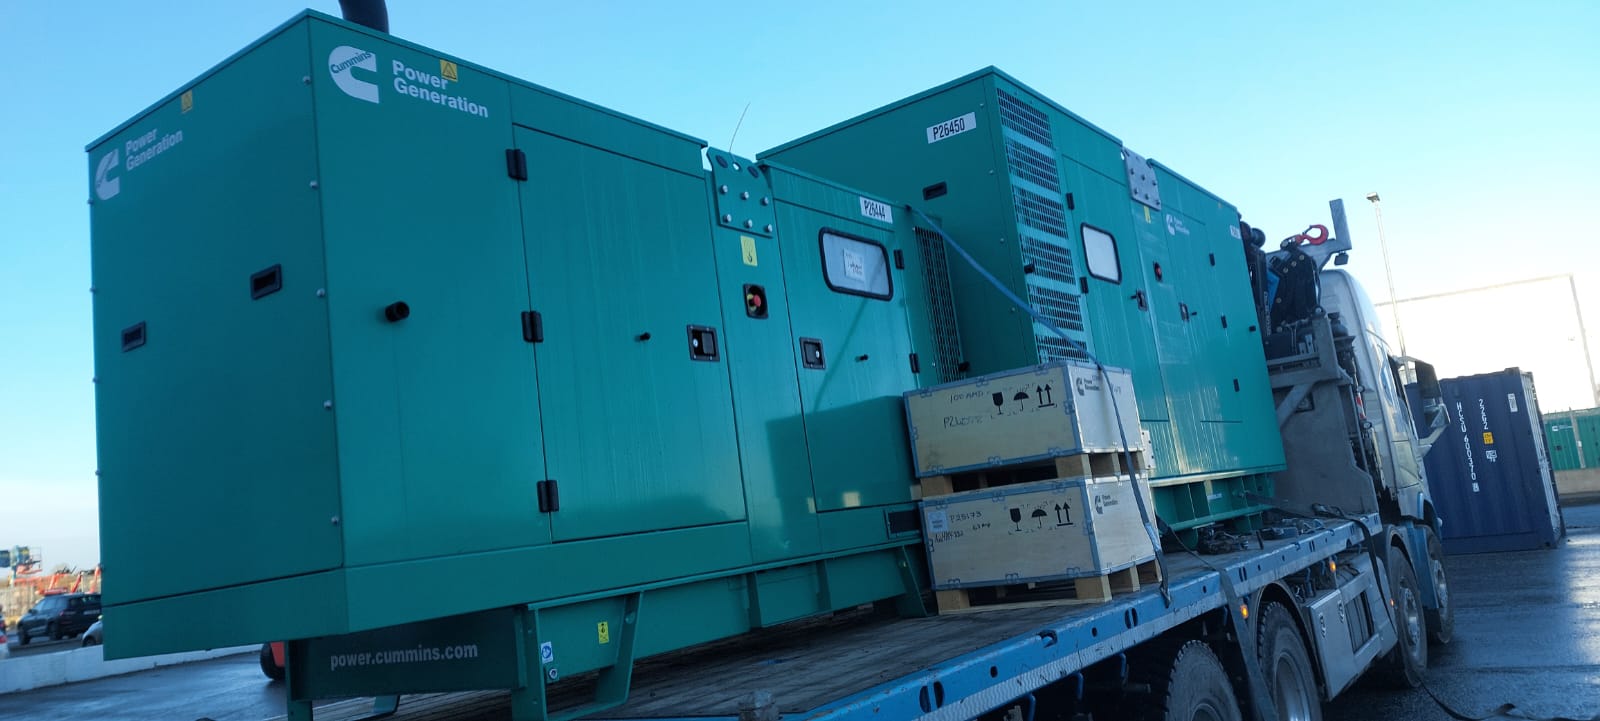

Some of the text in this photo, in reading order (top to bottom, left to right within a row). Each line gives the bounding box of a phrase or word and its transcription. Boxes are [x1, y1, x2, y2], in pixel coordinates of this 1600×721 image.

[330, 51, 372, 74] Cummins
[391, 59, 448, 90] Power
[393, 76, 488, 118] Generation
[126, 128, 157, 156] Power
[932, 117, 965, 140] P26450
[126, 130, 183, 171] Generation
[863, 200, 886, 219] P26444
[1463, 434, 1477, 481] 600370
[330, 643, 478, 671] power.cummins.com
